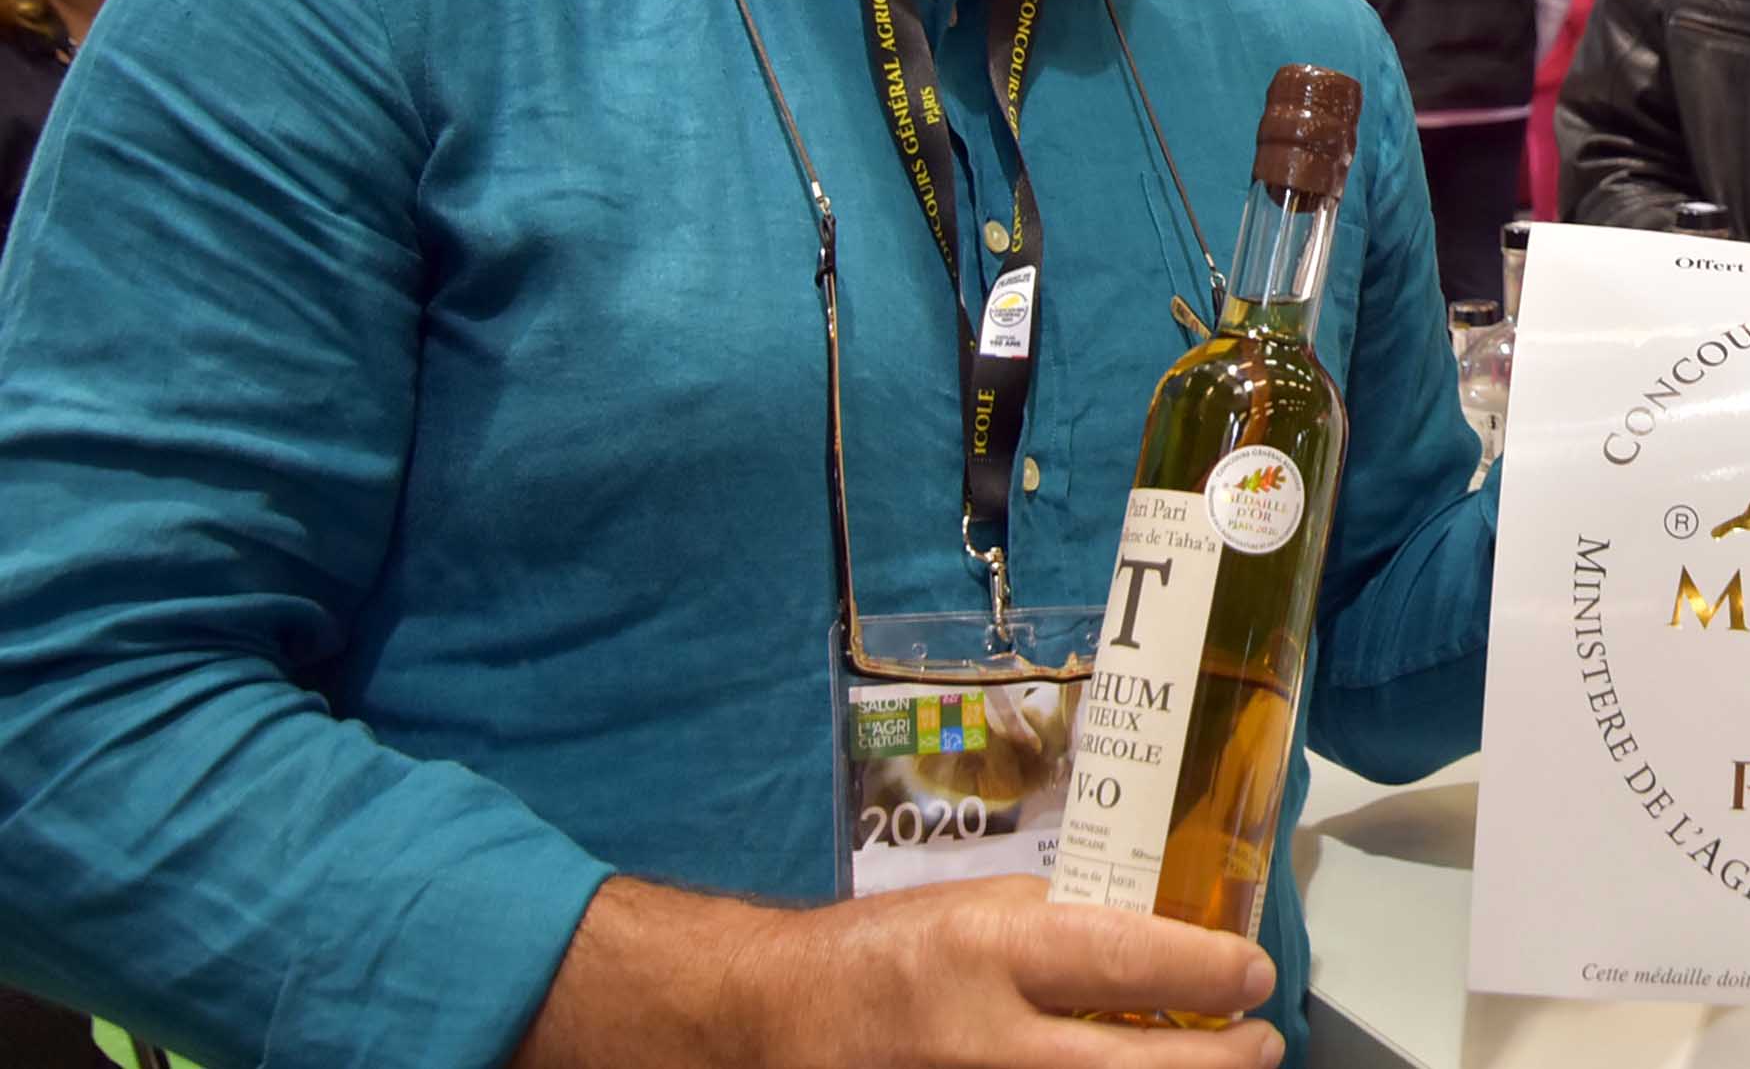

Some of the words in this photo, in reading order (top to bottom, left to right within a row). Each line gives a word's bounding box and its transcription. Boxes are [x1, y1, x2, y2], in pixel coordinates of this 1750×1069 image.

[884, 56, 920, 156] GÉNÉRAL
[920, 86, 945, 125] PARIS
[911, 157, 958, 279] ONCOURS
[1675, 256, 1744, 272] Offert
[1153, 498, 1189, 522] Pari
[1110, 554, 1173, 650] T
[1573, 534, 1638, 763] MINISTERE
[1624, 761, 1674, 820] DE
[857, 698, 911, 713] SALON
[1088, 705, 1143, 732] VIEUX
[858, 733, 911, 749] CULTURE
[1080, 732, 1163, 767] GRICOLE
[860, 795, 987, 851] 2020
[1581, 962, 1629, 983] Cette
[1634, 966, 1711, 987] médaille
